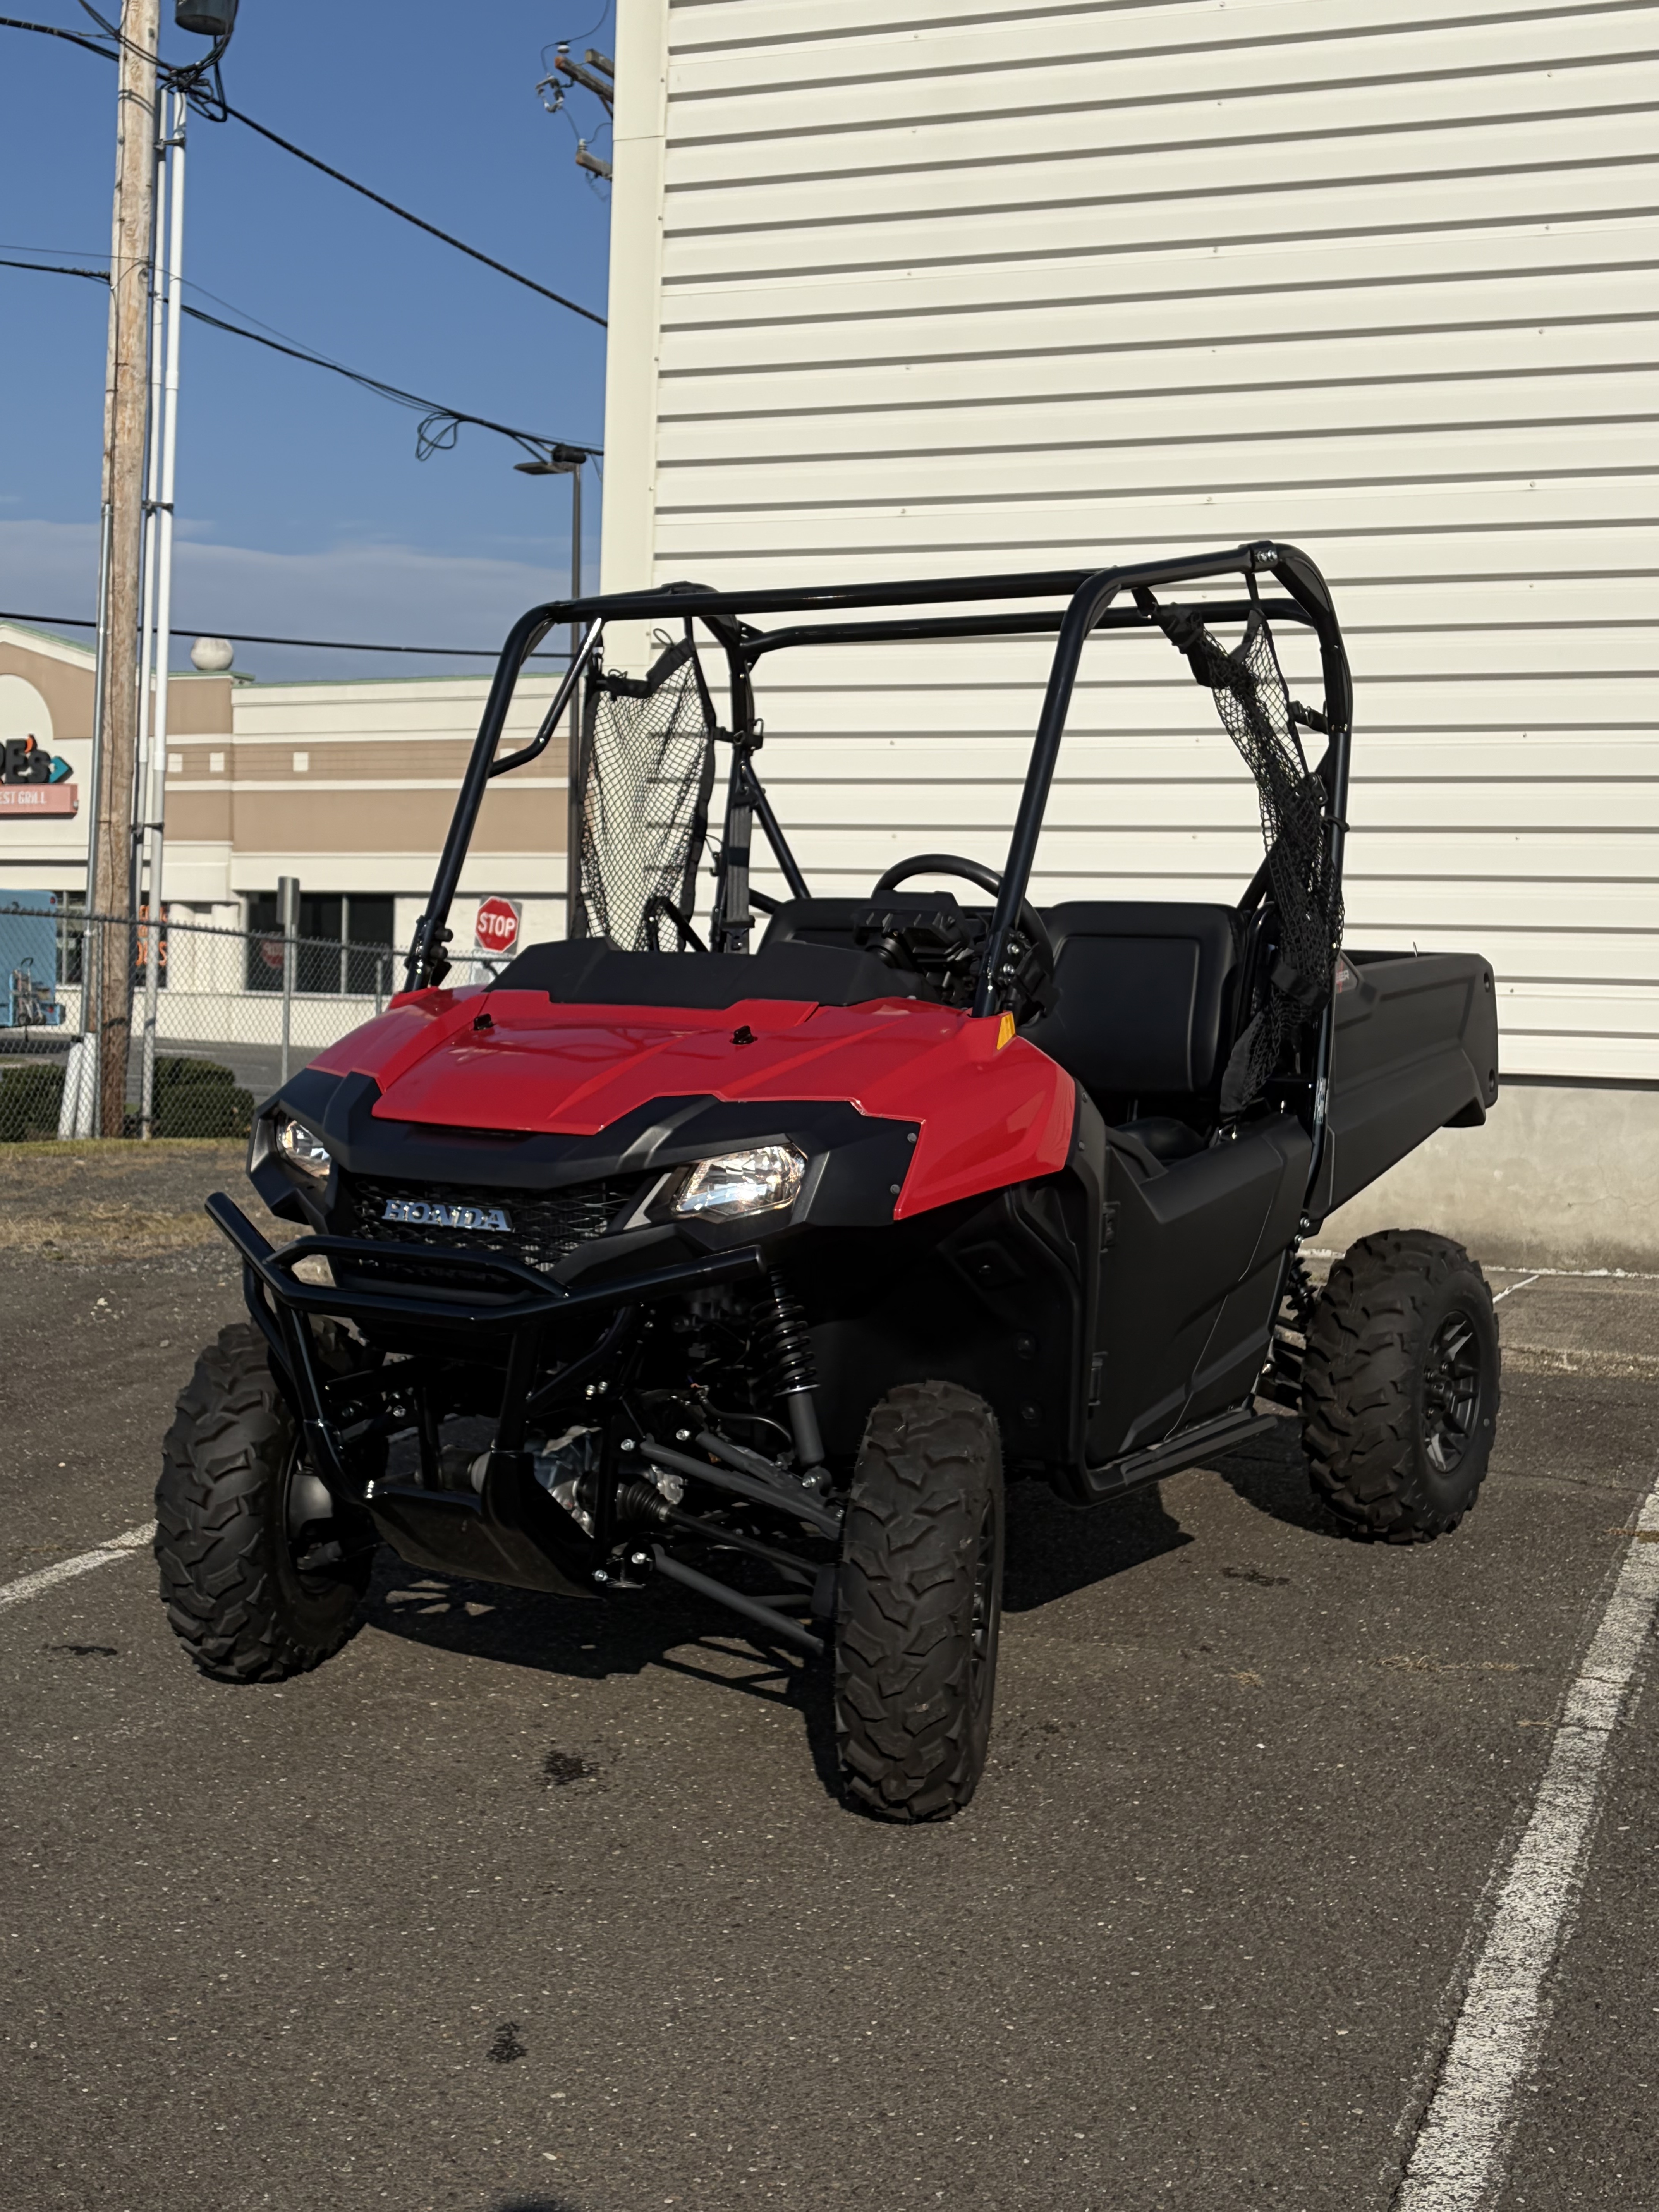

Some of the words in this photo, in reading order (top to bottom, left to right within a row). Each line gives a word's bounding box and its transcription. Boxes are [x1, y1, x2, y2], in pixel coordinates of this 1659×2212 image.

[18, 791, 46, 804] GRILL
[478, 912, 515, 938] STOP
[382, 1199, 511, 1232] HONDA
